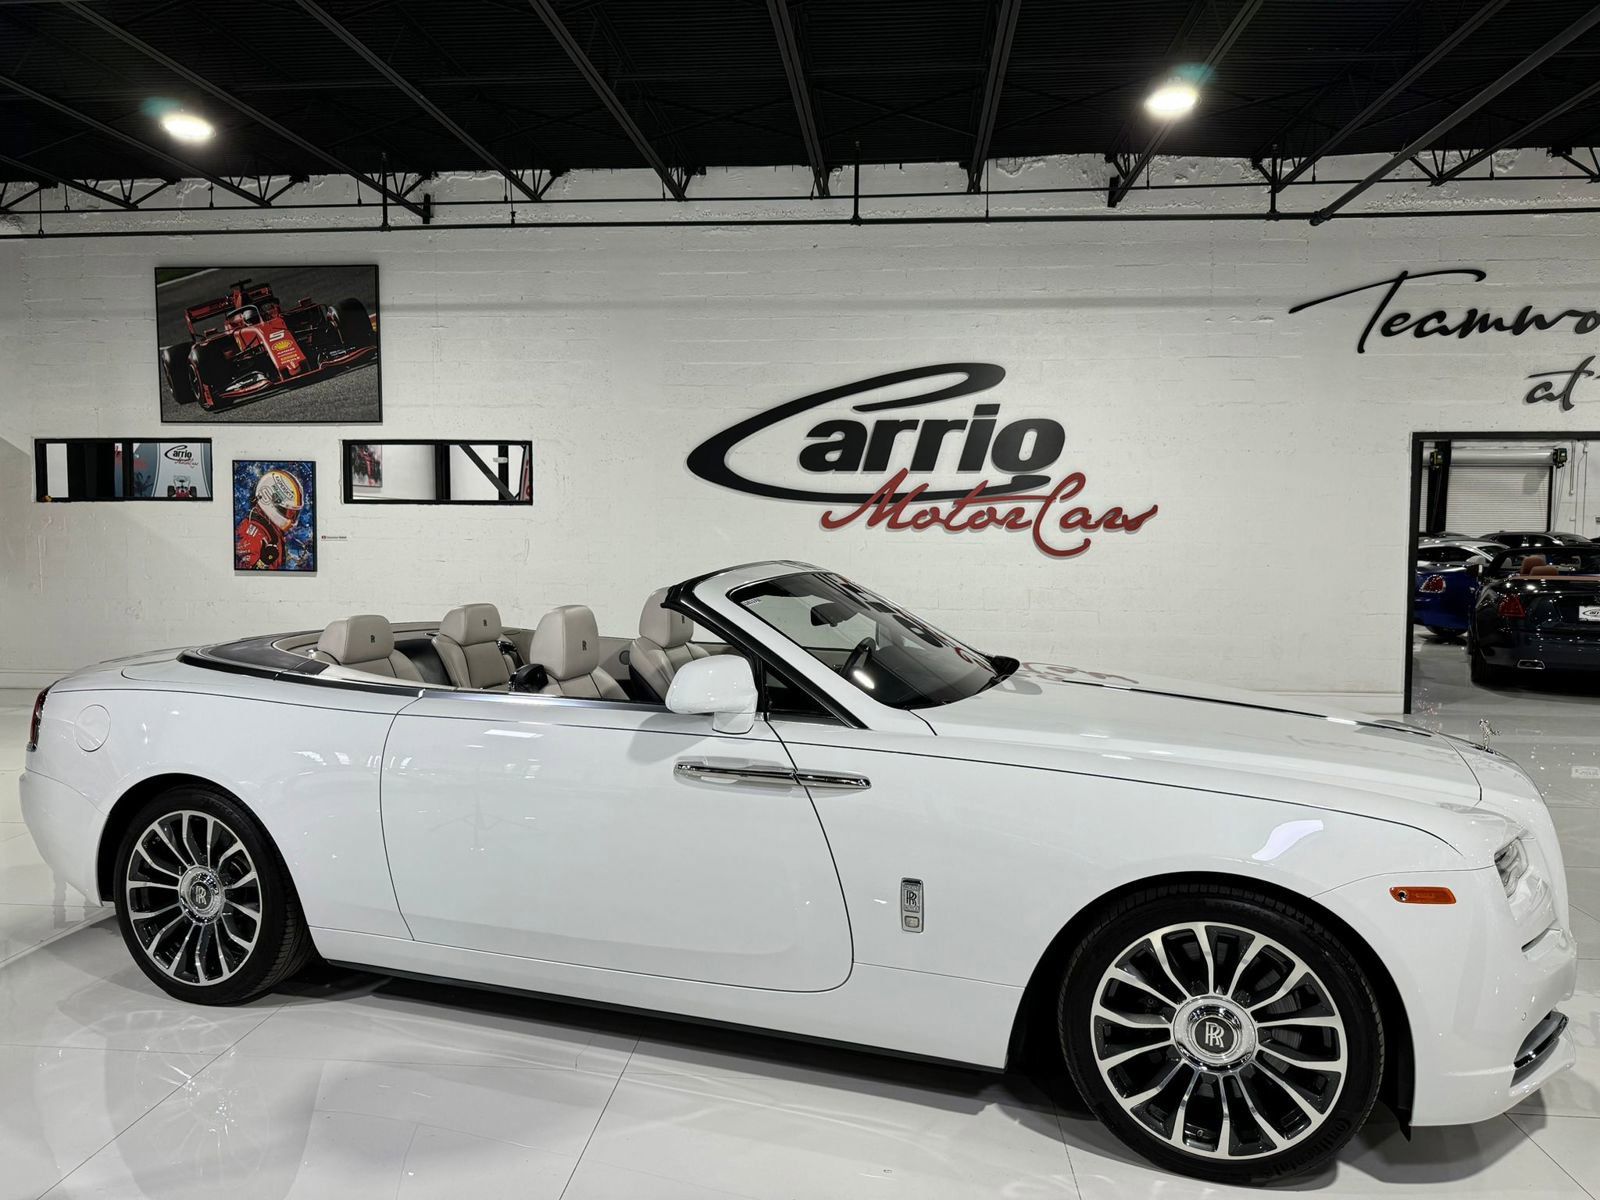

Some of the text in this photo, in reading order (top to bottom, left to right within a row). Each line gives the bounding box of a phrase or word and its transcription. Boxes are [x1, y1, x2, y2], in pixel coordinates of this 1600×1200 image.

[1525, 355, 1595, 411] at
[686, 362, 1066, 502] Carrio
[1205, 1021, 1225, 1048] RR
